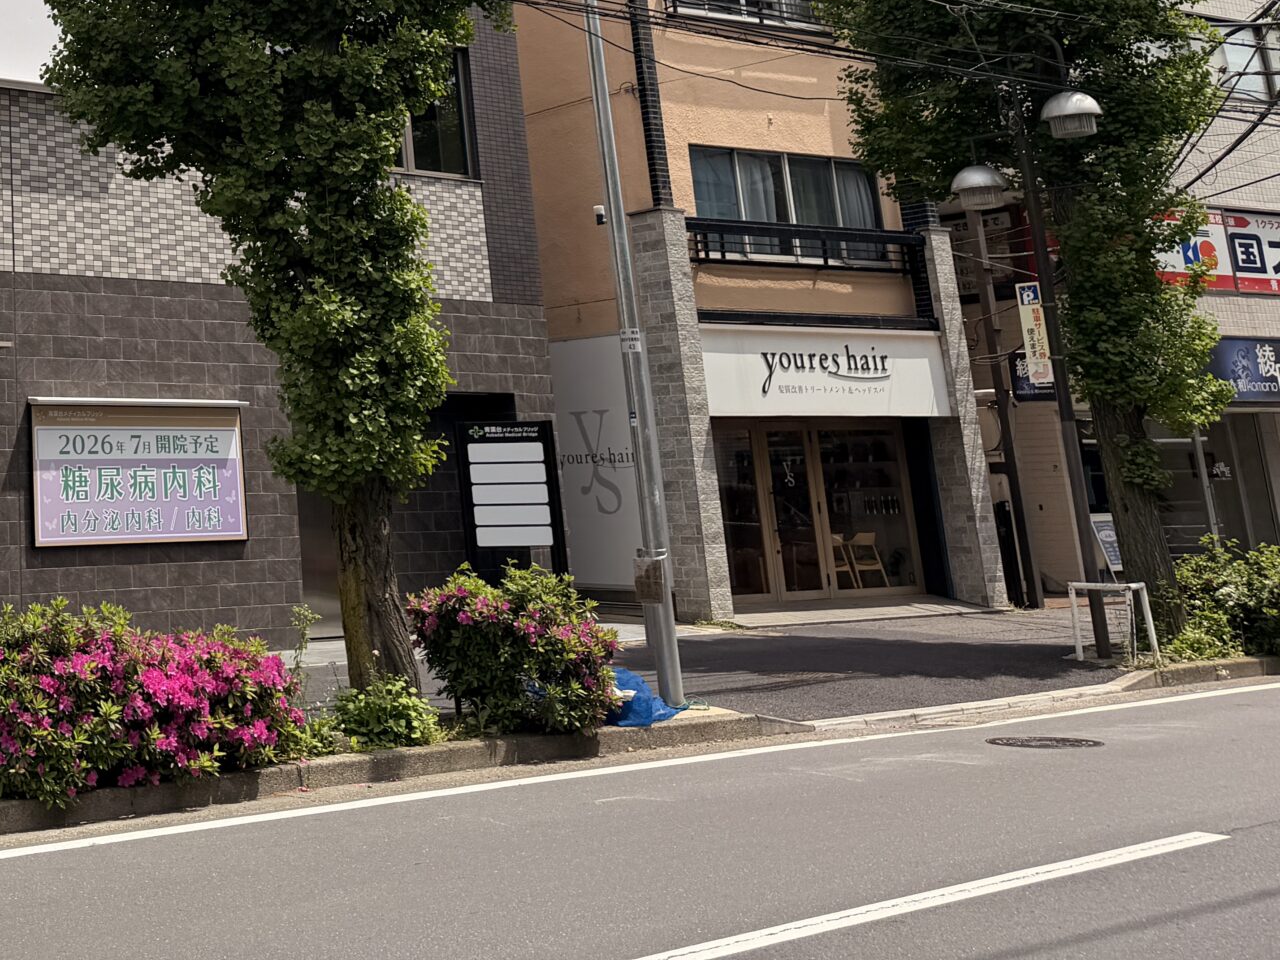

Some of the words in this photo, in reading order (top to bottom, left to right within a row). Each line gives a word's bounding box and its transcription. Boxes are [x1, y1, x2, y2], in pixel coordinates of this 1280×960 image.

[761, 351, 841, 395] youres
[843, 344, 888, 372] hair
[1255, 343, 1280, 387] 綾
[60, 463, 220, 502] 糖尿病内科
